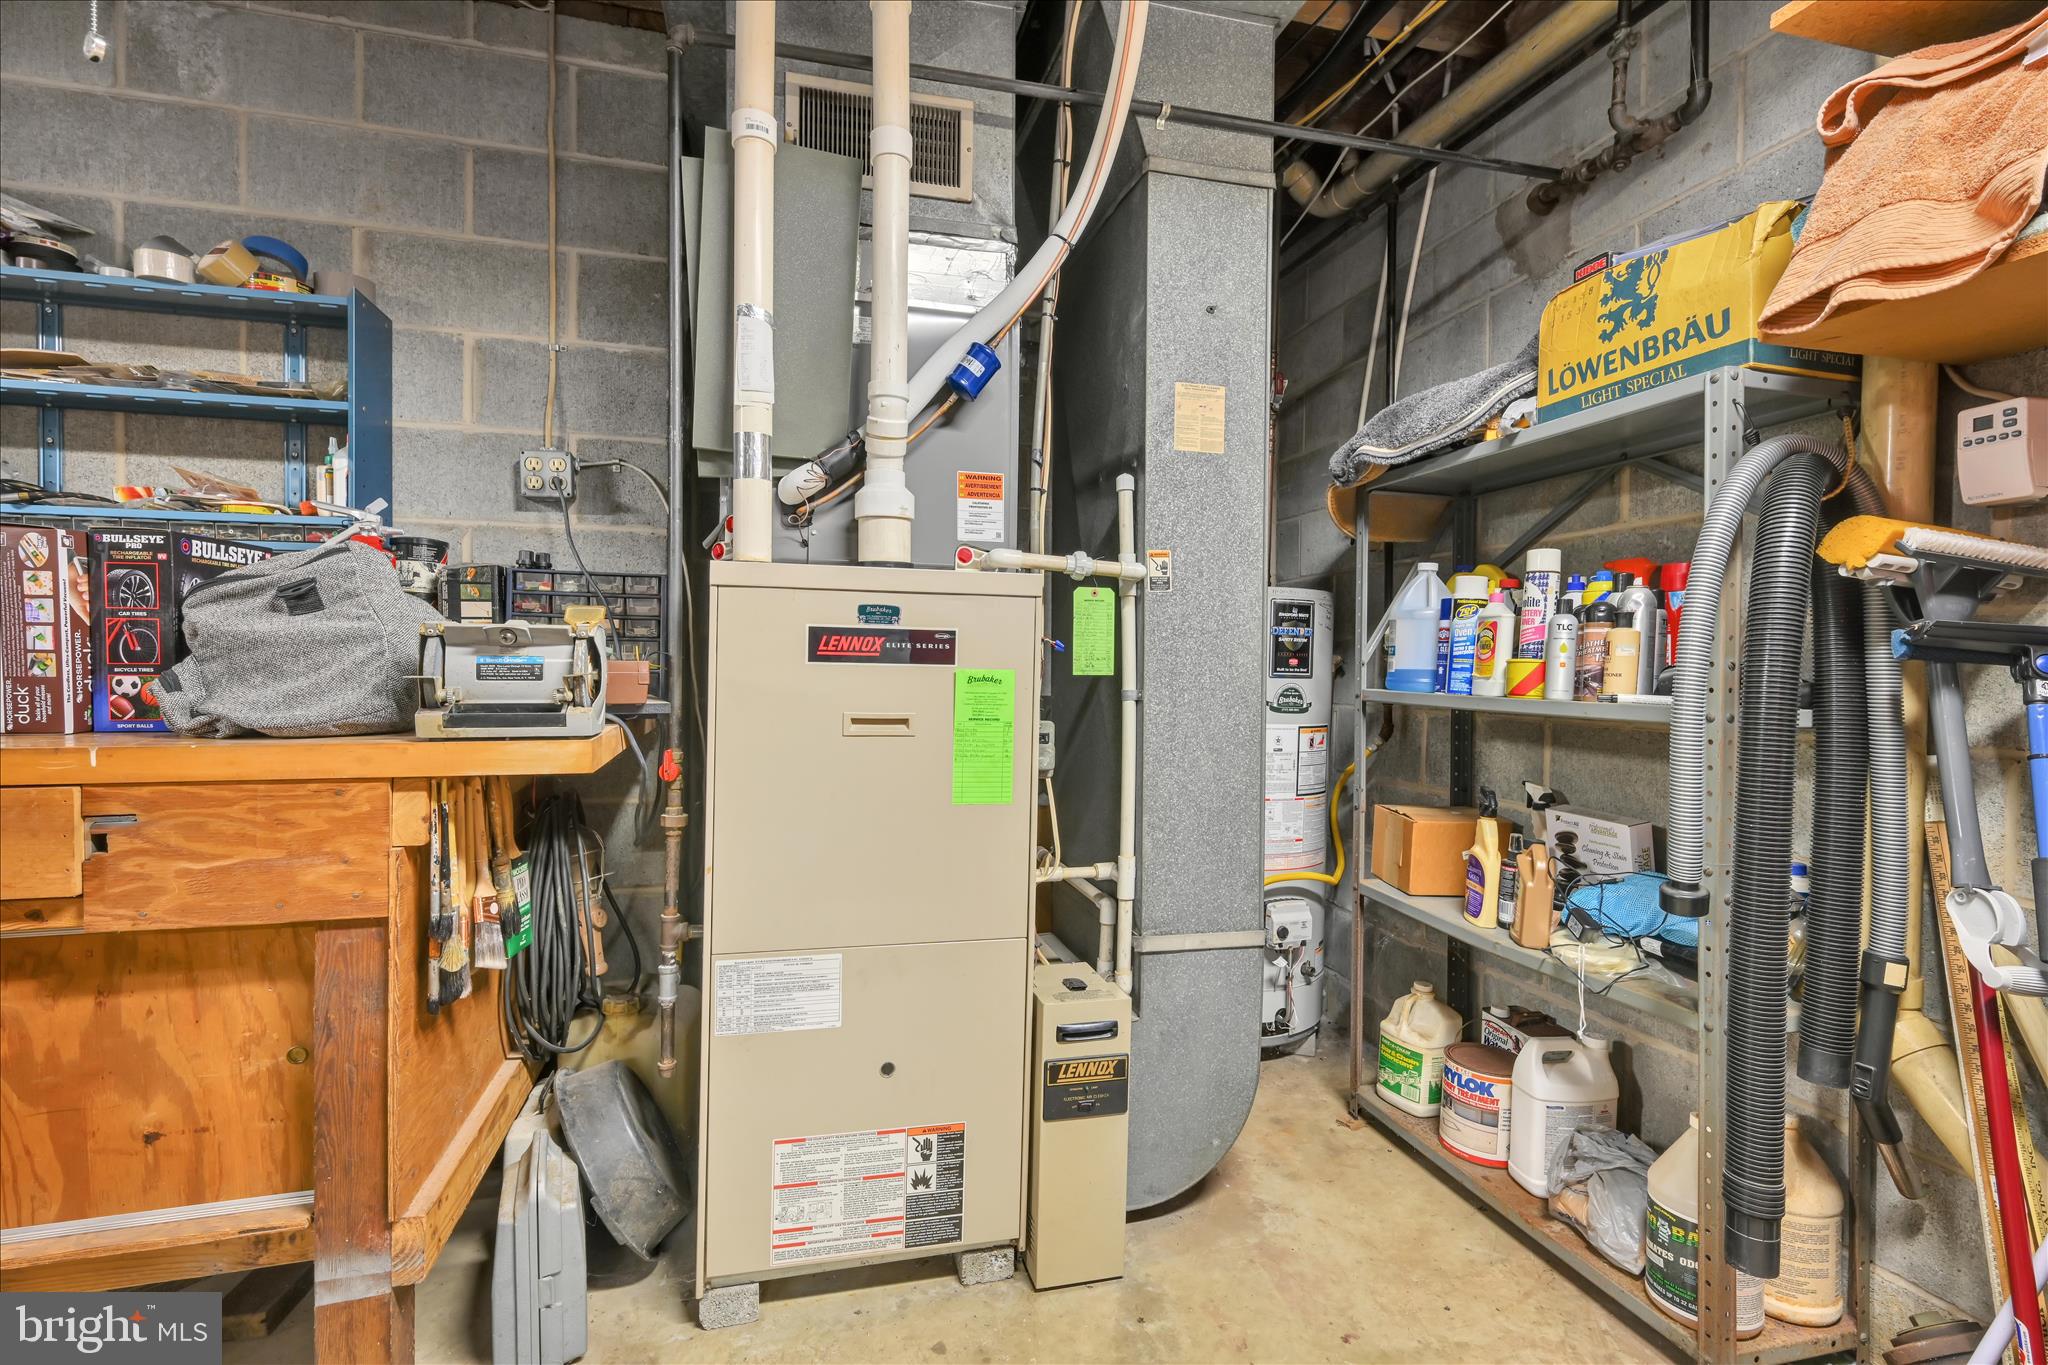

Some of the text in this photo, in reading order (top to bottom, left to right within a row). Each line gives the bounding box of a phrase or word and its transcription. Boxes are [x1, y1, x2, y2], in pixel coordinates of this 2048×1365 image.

[1575, 257, 1607, 280] KIDDE
[1548, 307, 1730, 396] LÖWENBRÄU
[1790, 348, 1818, 360] LIGHT
[1581, 364, 1688, 409] LIGHT SPECIAL
[102, 534, 164, 544] BULLSEYE
[192, 539, 263, 565] BULLSEYE
[1455, 629, 1472, 637] Oven
[1557, 623, 1573, 631] TLC
[818, 634, 886, 652] LENNOX
[967, 675, 1002, 685] Brubaker
[1582, 844, 1603, 860] Cleaning
[1612, 852, 1627, 862] Stain
[1592, 858, 1619, 871] Protection
[1484, 1027, 1509, 1046] Original
[1058, 1060, 1118, 1079] LENNOX
[1458, 1088, 1500, 1105] TREATMENT
[2026, 1144, 2036, 1169] INC.
